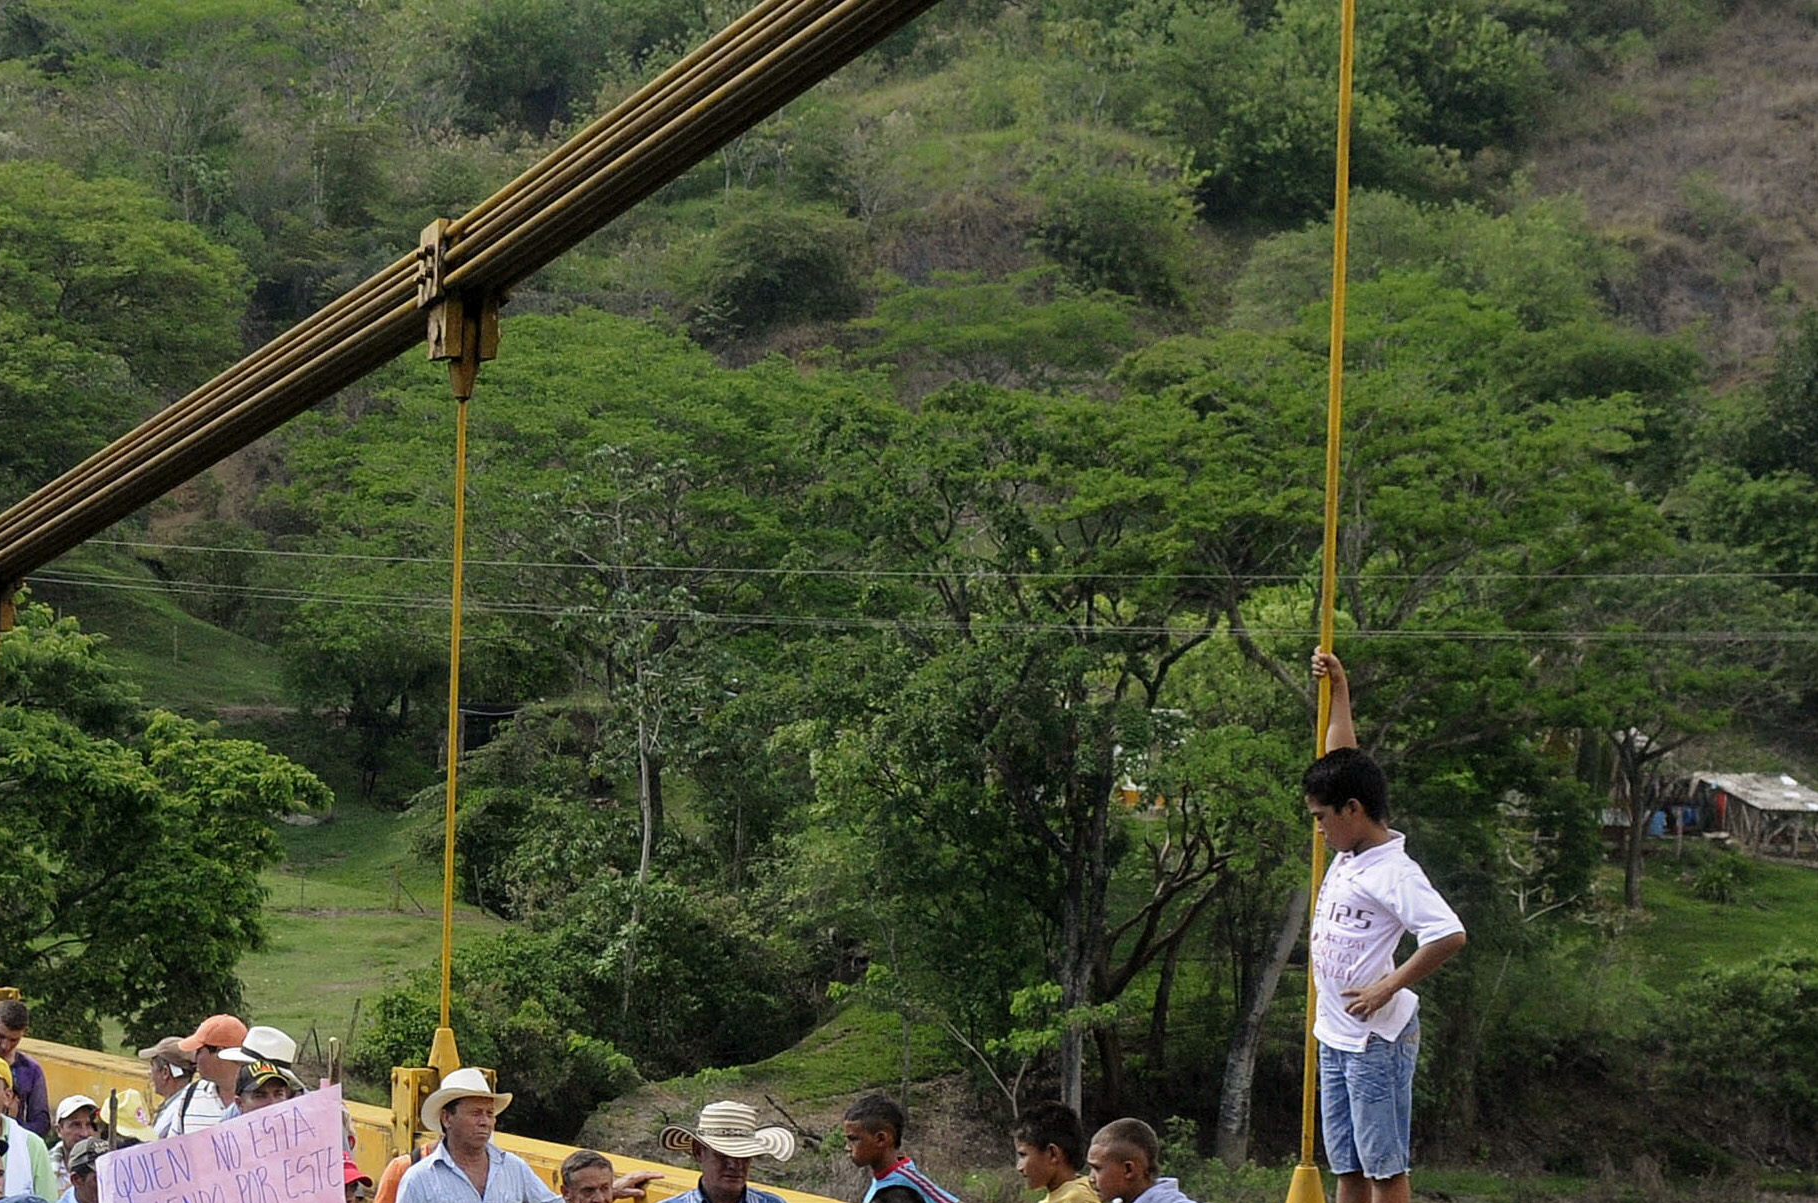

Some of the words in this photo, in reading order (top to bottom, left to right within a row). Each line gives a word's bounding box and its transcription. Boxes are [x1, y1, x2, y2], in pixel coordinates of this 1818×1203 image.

[1329, 902, 1375, 930] 125
[210, 1130, 242, 1172] NO
[249, 1106, 316, 1159] ESTA
[283, 1146, 342, 1199] ESTE
